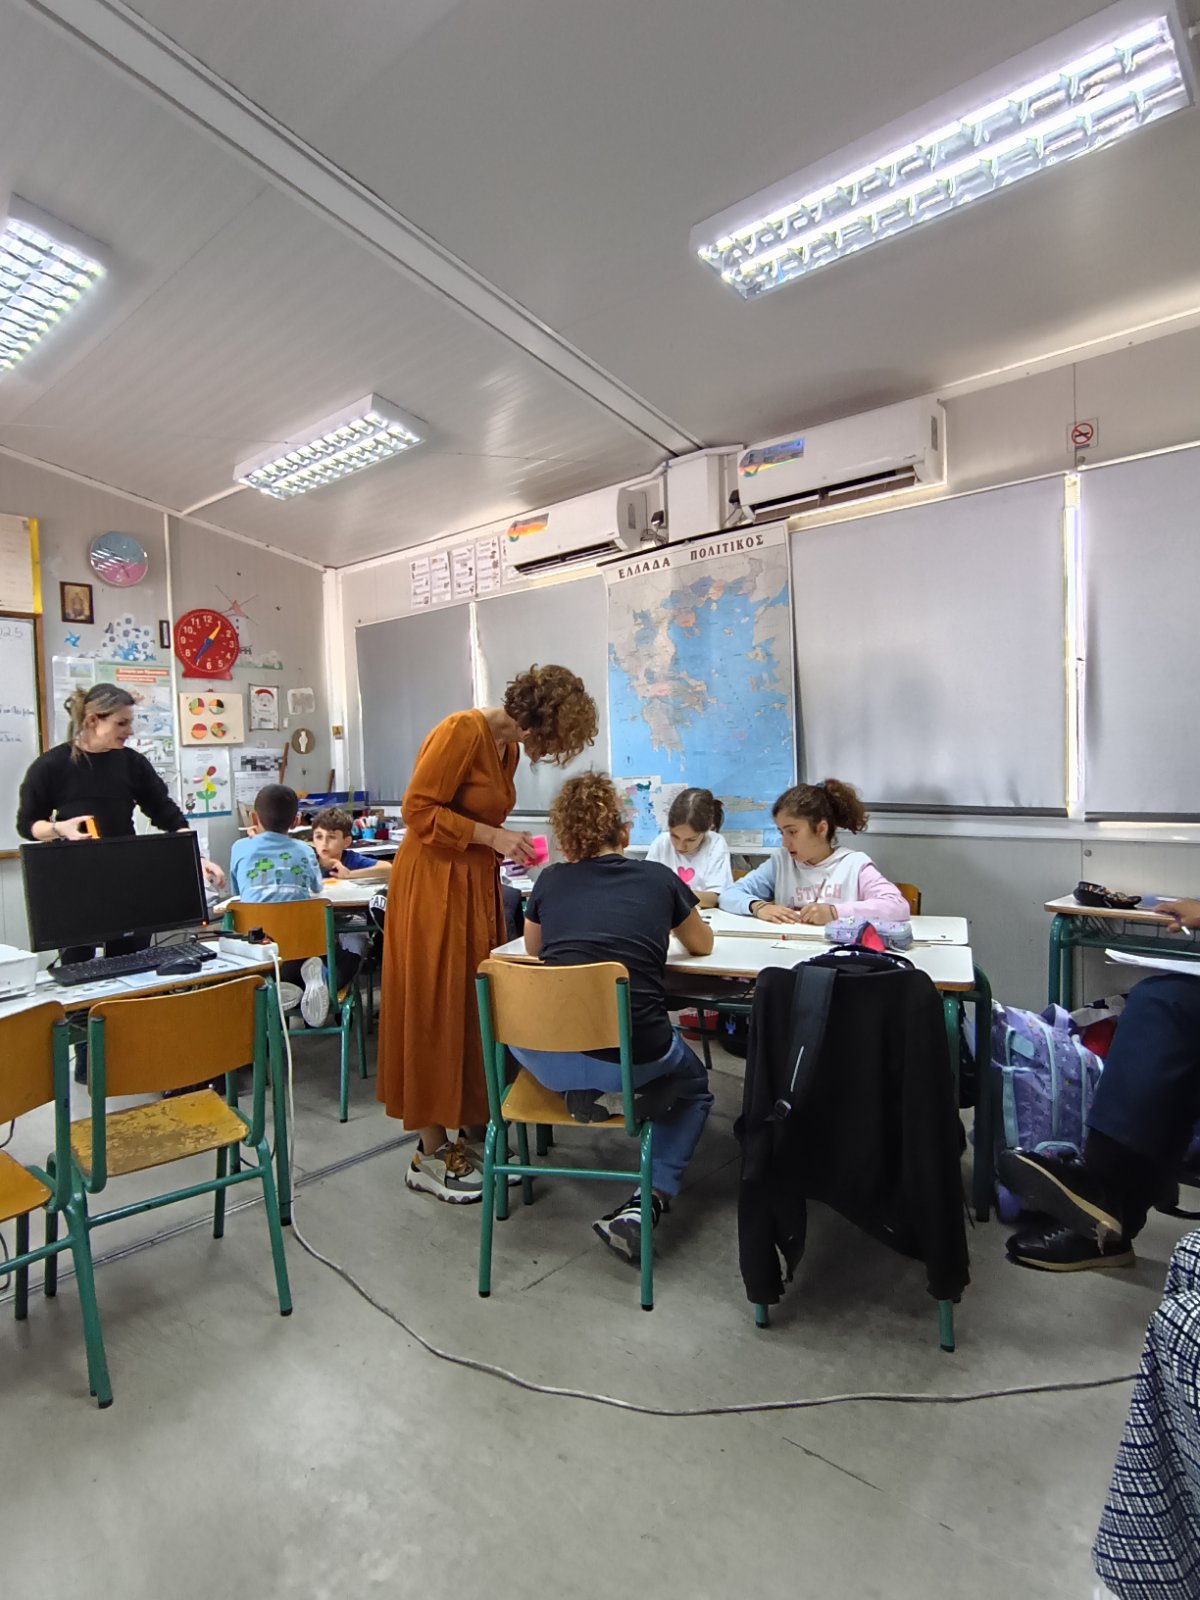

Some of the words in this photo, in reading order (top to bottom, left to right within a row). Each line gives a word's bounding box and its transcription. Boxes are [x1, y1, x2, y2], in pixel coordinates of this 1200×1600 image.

[618, 557, 671, 579] ΕΛΛΑΔΑ
[690, 535, 764, 561] ΠΟΛΙΤΙΚΟΣ
[191, 618, 200, 626] 11
[183, 626, 193, 634] 10
[226, 630, 231, 638] 2
[180, 636, 186, 644] 9
[185, 649, 191, 657] 8
[206, 662, 212, 670] 6
